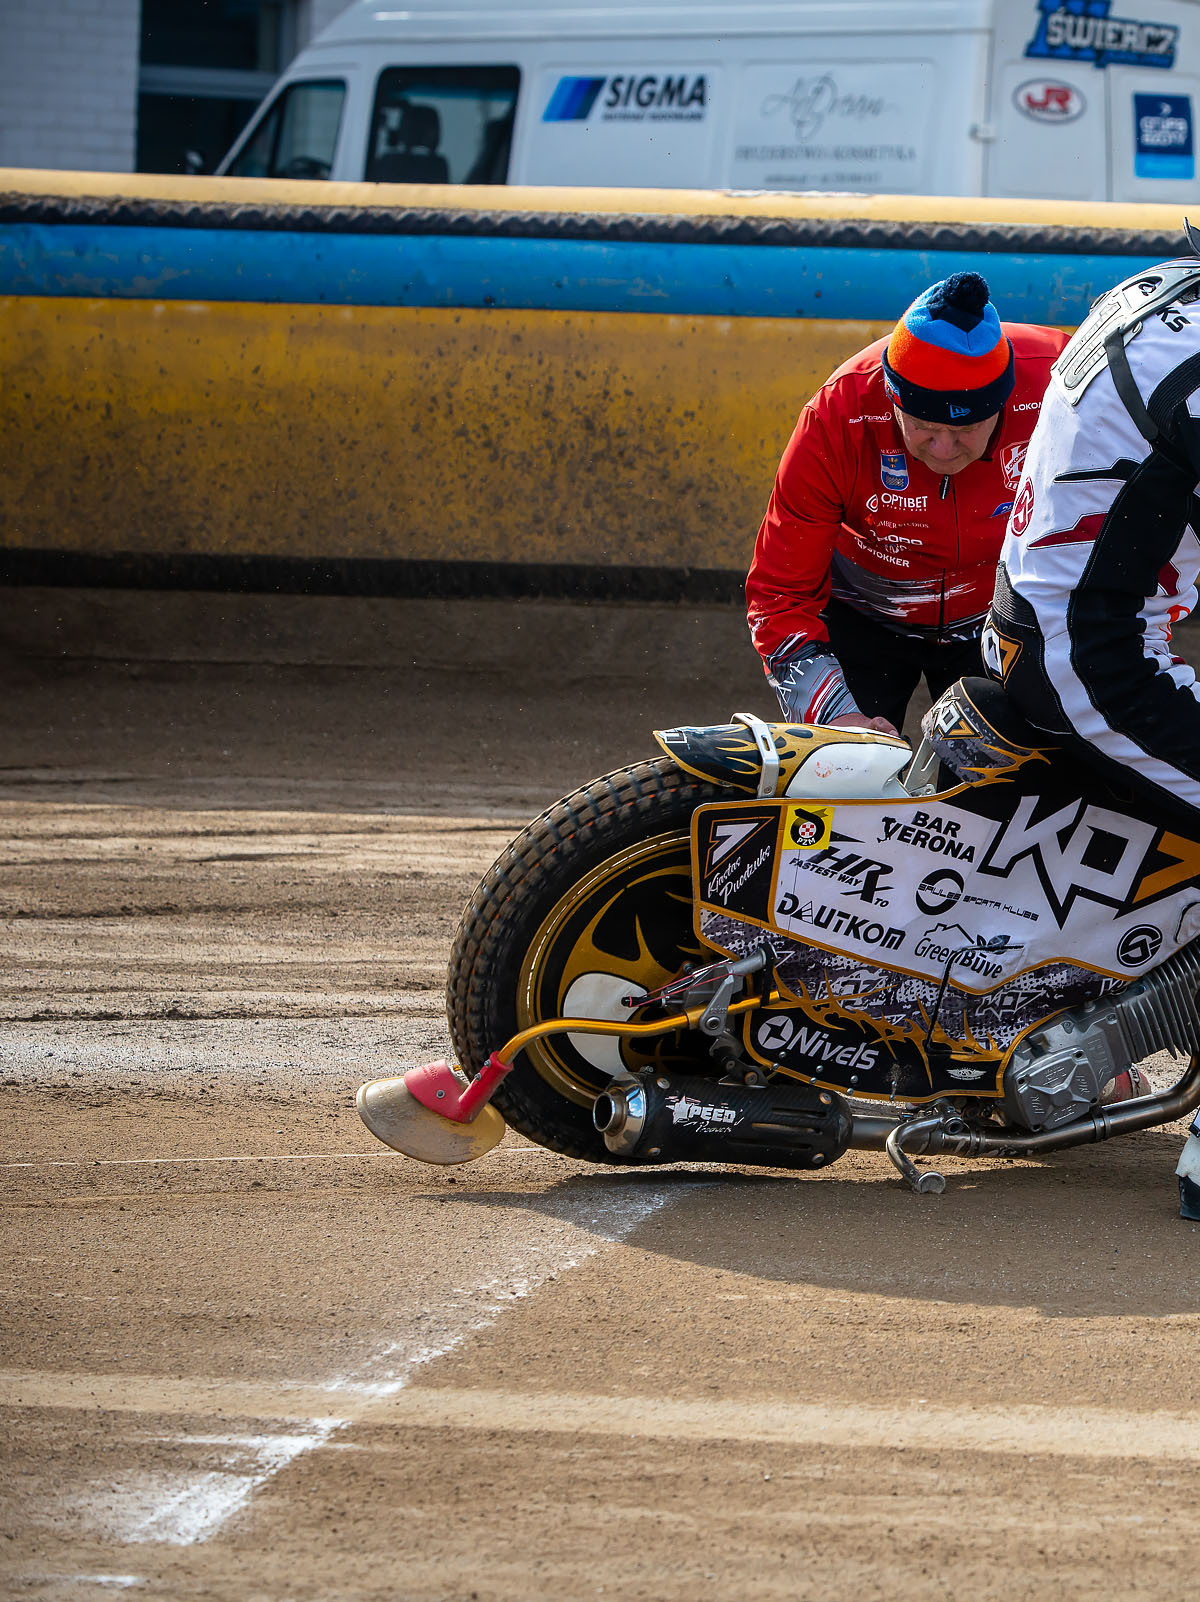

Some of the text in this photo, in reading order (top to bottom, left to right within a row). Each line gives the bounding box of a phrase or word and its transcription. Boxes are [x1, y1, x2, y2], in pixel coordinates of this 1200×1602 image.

[606, 75, 707, 108] SIGMA
[1025, 86, 1071, 112] JR
[881, 493, 928, 508] OPTIBET
[910, 810, 962, 838] BAR
[797, 837, 816, 846] PZM
[878, 817, 976, 863] VERONA
[788, 857, 890, 908] FASTEST WAY TO
[918, 883, 961, 900] SAULES
[962, 895, 1001, 909] SPORTA
[776, 892, 906, 950] DAUTKOM
[786, 1025, 880, 1070] Nivels
